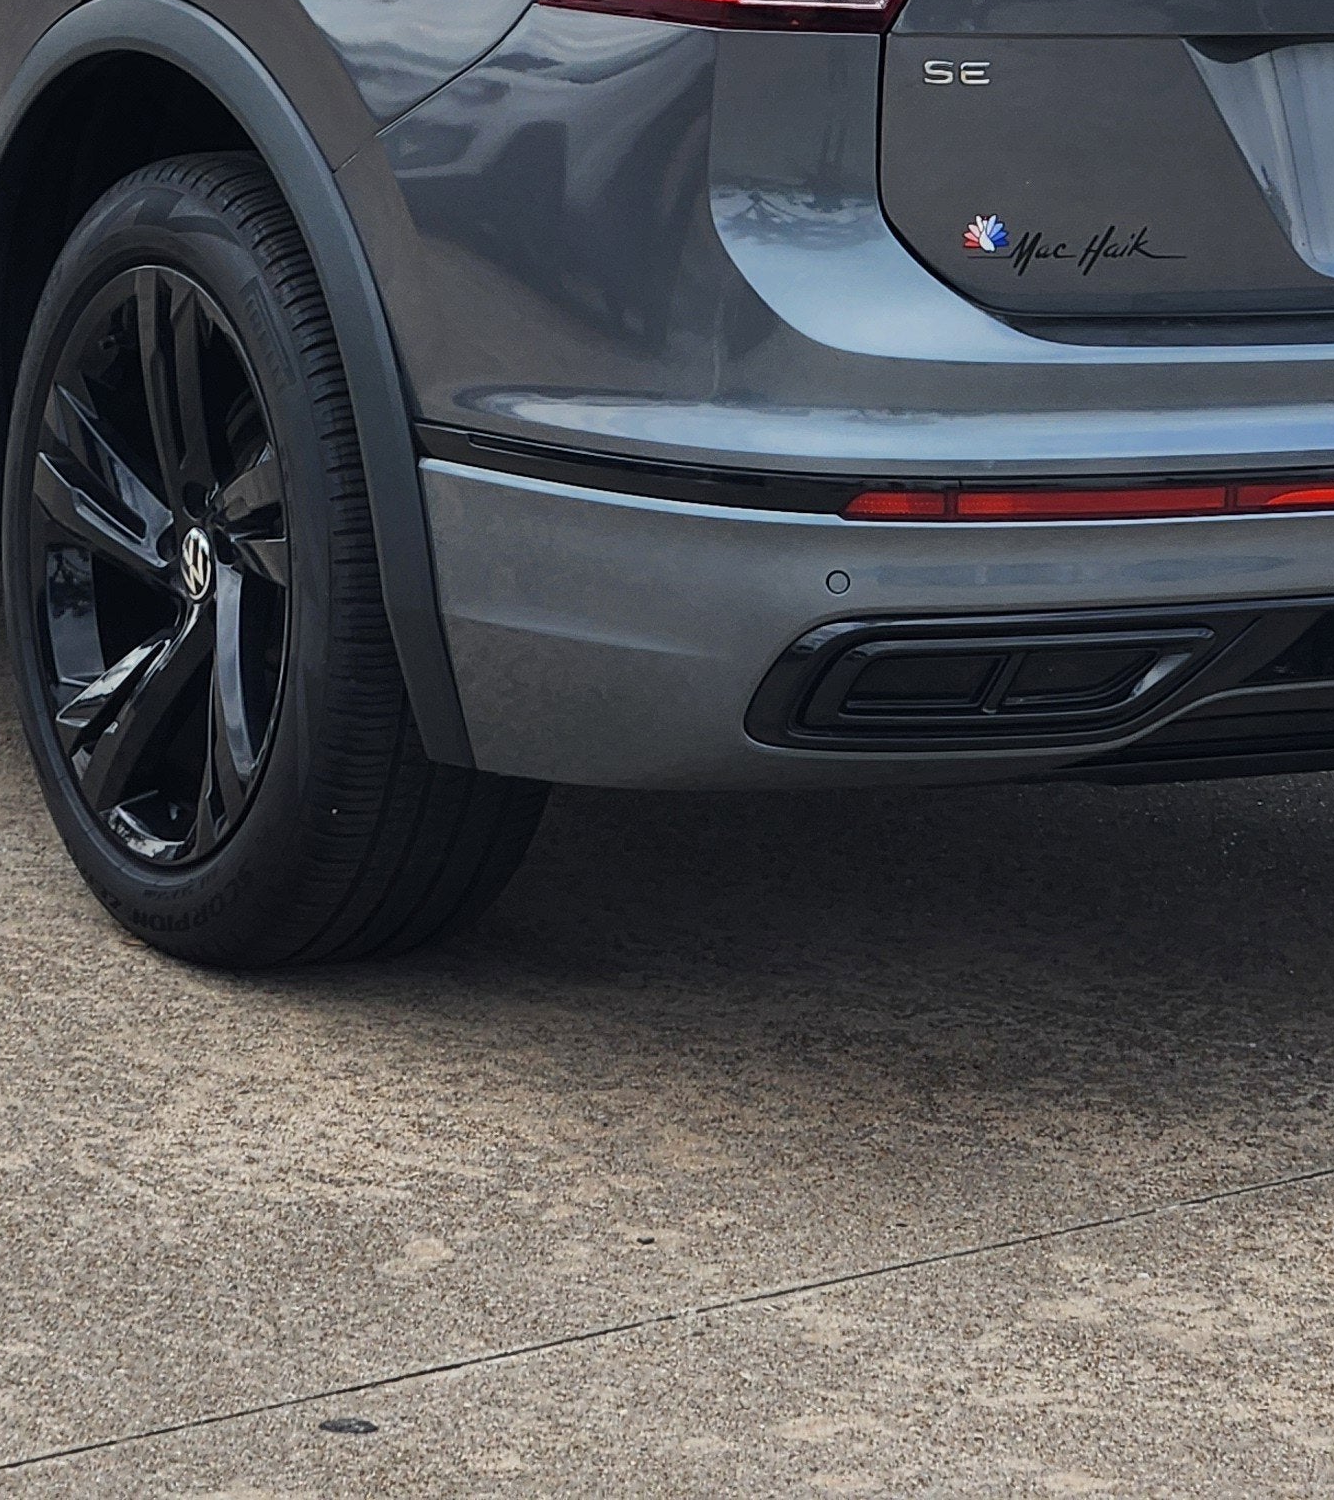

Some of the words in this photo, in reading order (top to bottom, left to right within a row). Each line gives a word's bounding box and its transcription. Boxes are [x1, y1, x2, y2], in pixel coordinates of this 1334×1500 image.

[923, 59, 991, 85] SE
[1010, 231, 1074, 276] Mac
[1077, 225, 1159, 276] Haik
